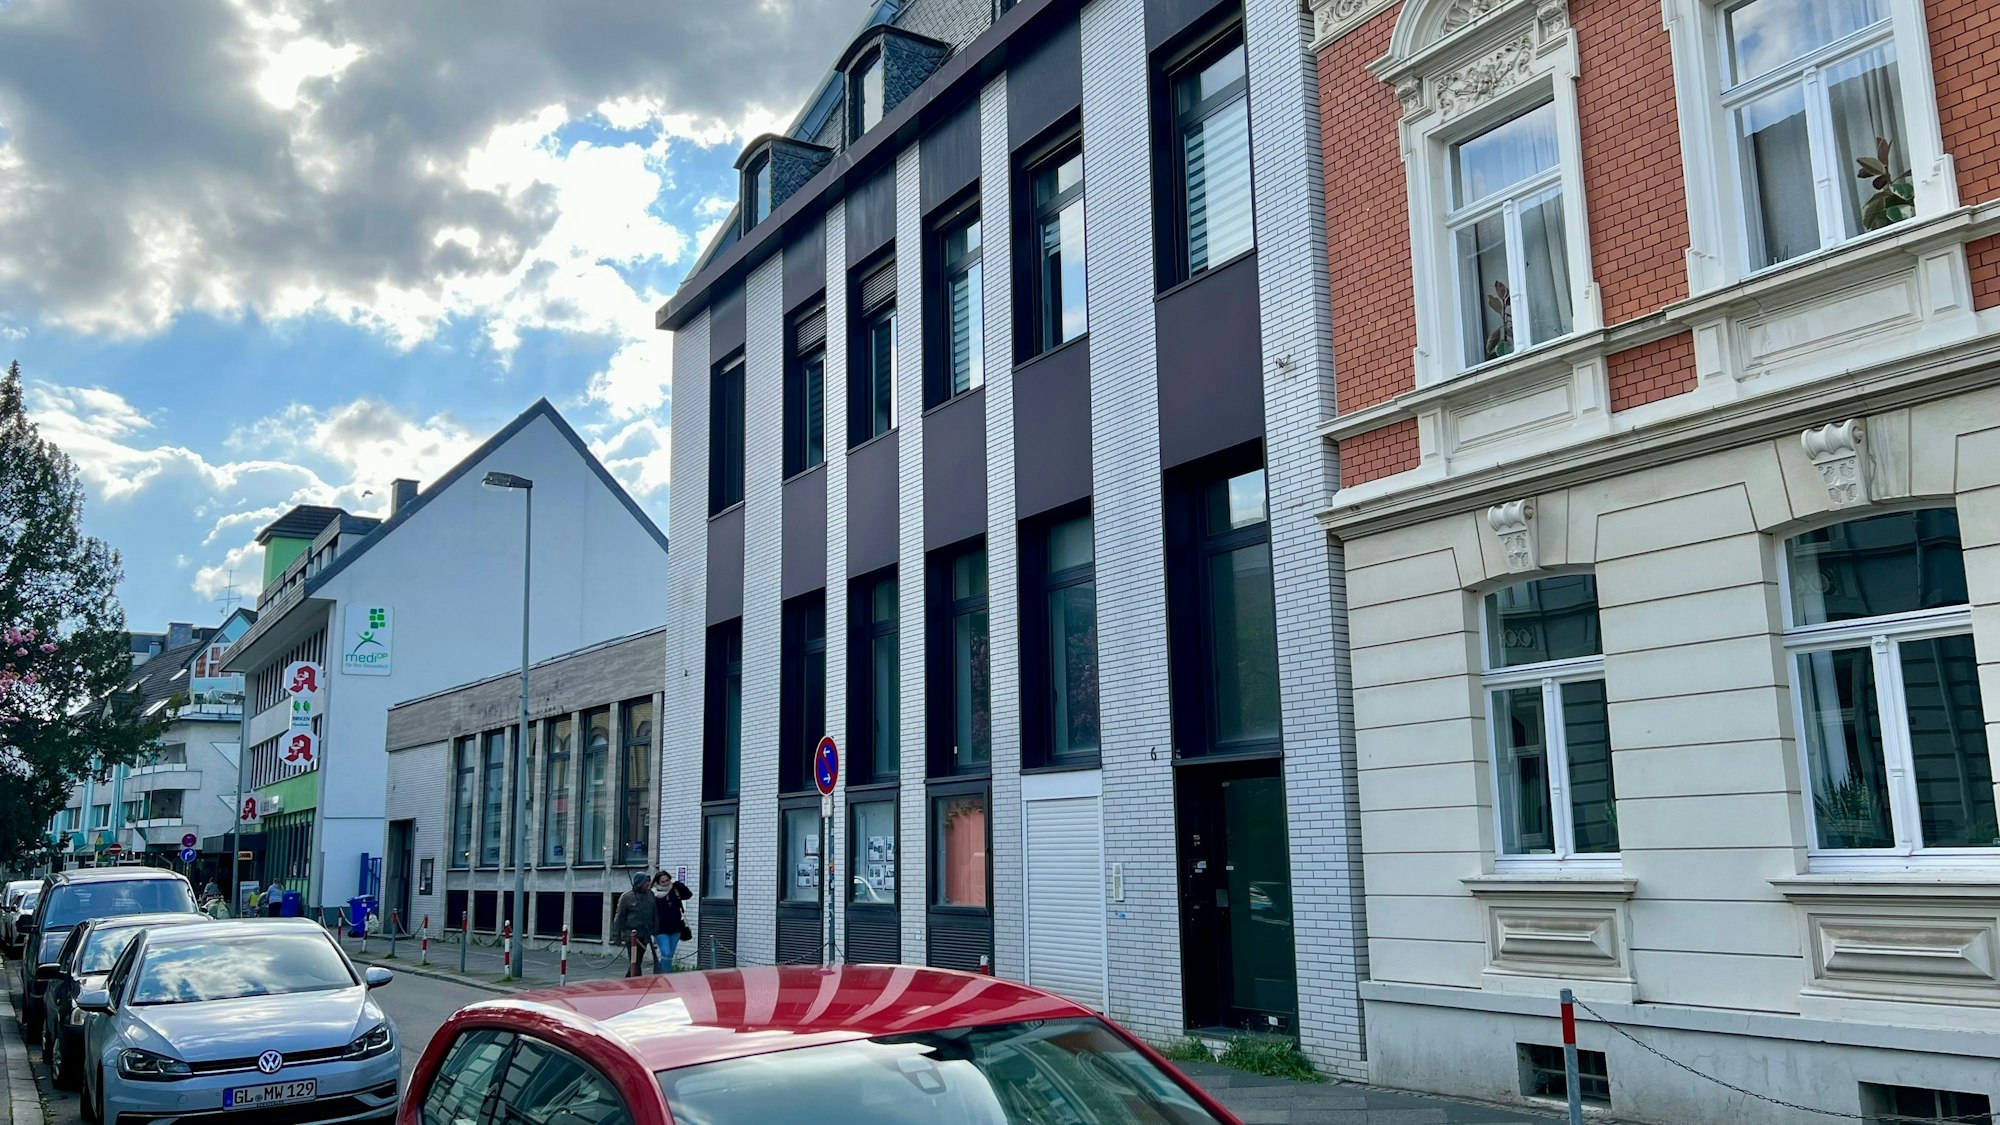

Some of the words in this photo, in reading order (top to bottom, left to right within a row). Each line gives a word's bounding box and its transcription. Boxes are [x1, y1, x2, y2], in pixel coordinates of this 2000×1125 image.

[1150, 747, 1157, 761] 6
[234, 1089, 253, 1104] GL
[264, 1085, 283, 1100] MW
[287, 1082, 314, 1098] 129
